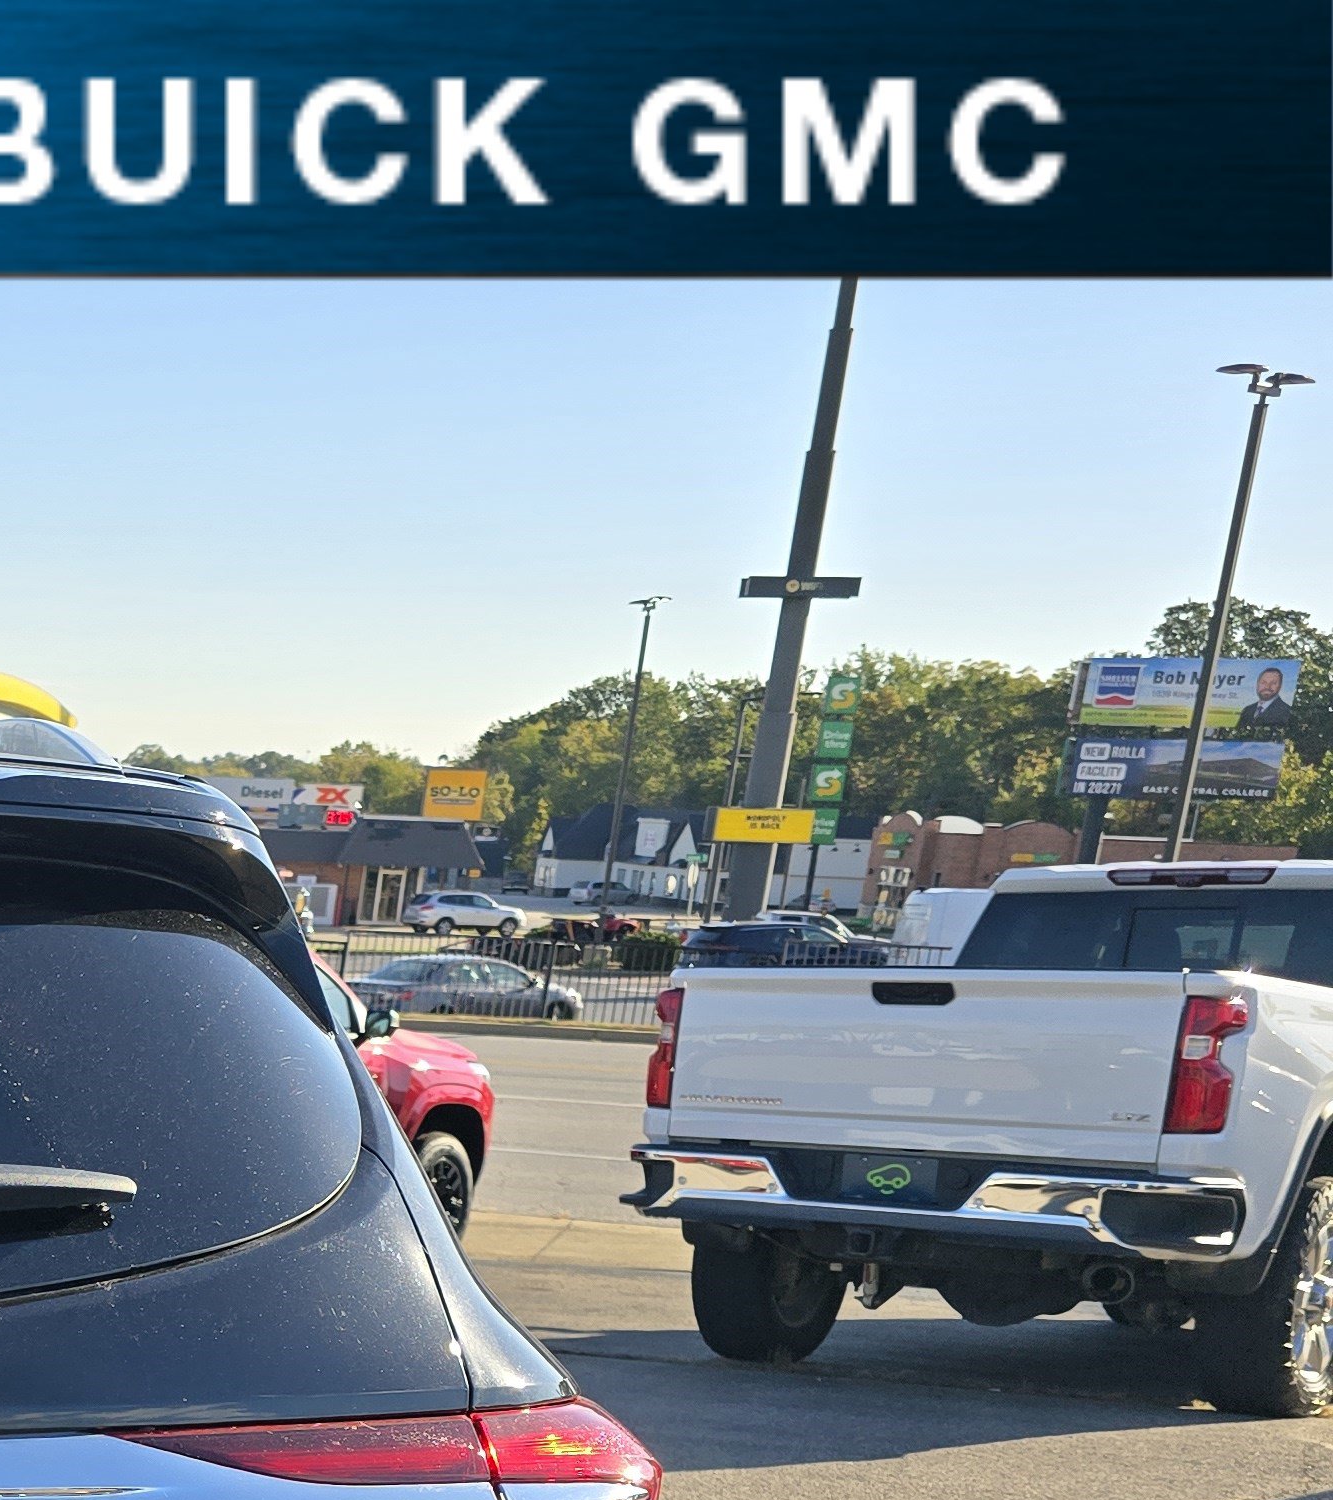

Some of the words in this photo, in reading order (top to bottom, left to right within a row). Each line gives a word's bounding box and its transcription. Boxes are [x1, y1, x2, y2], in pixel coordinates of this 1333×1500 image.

[1152, 670, 1186, 685] Bob
[1083, 746, 1107, 758] NEW
[1111, 745, 1146, 759] ROLLA
[1079, 765, 1123, 778] FACILITY
[240, 785, 284, 799] Diesel
[315, 787, 350, 805] ZX
[430, 785, 481, 799] SO-LO
[1142, 785, 1170, 795] EAST
[1221, 787, 1270, 798] COLLEGE
